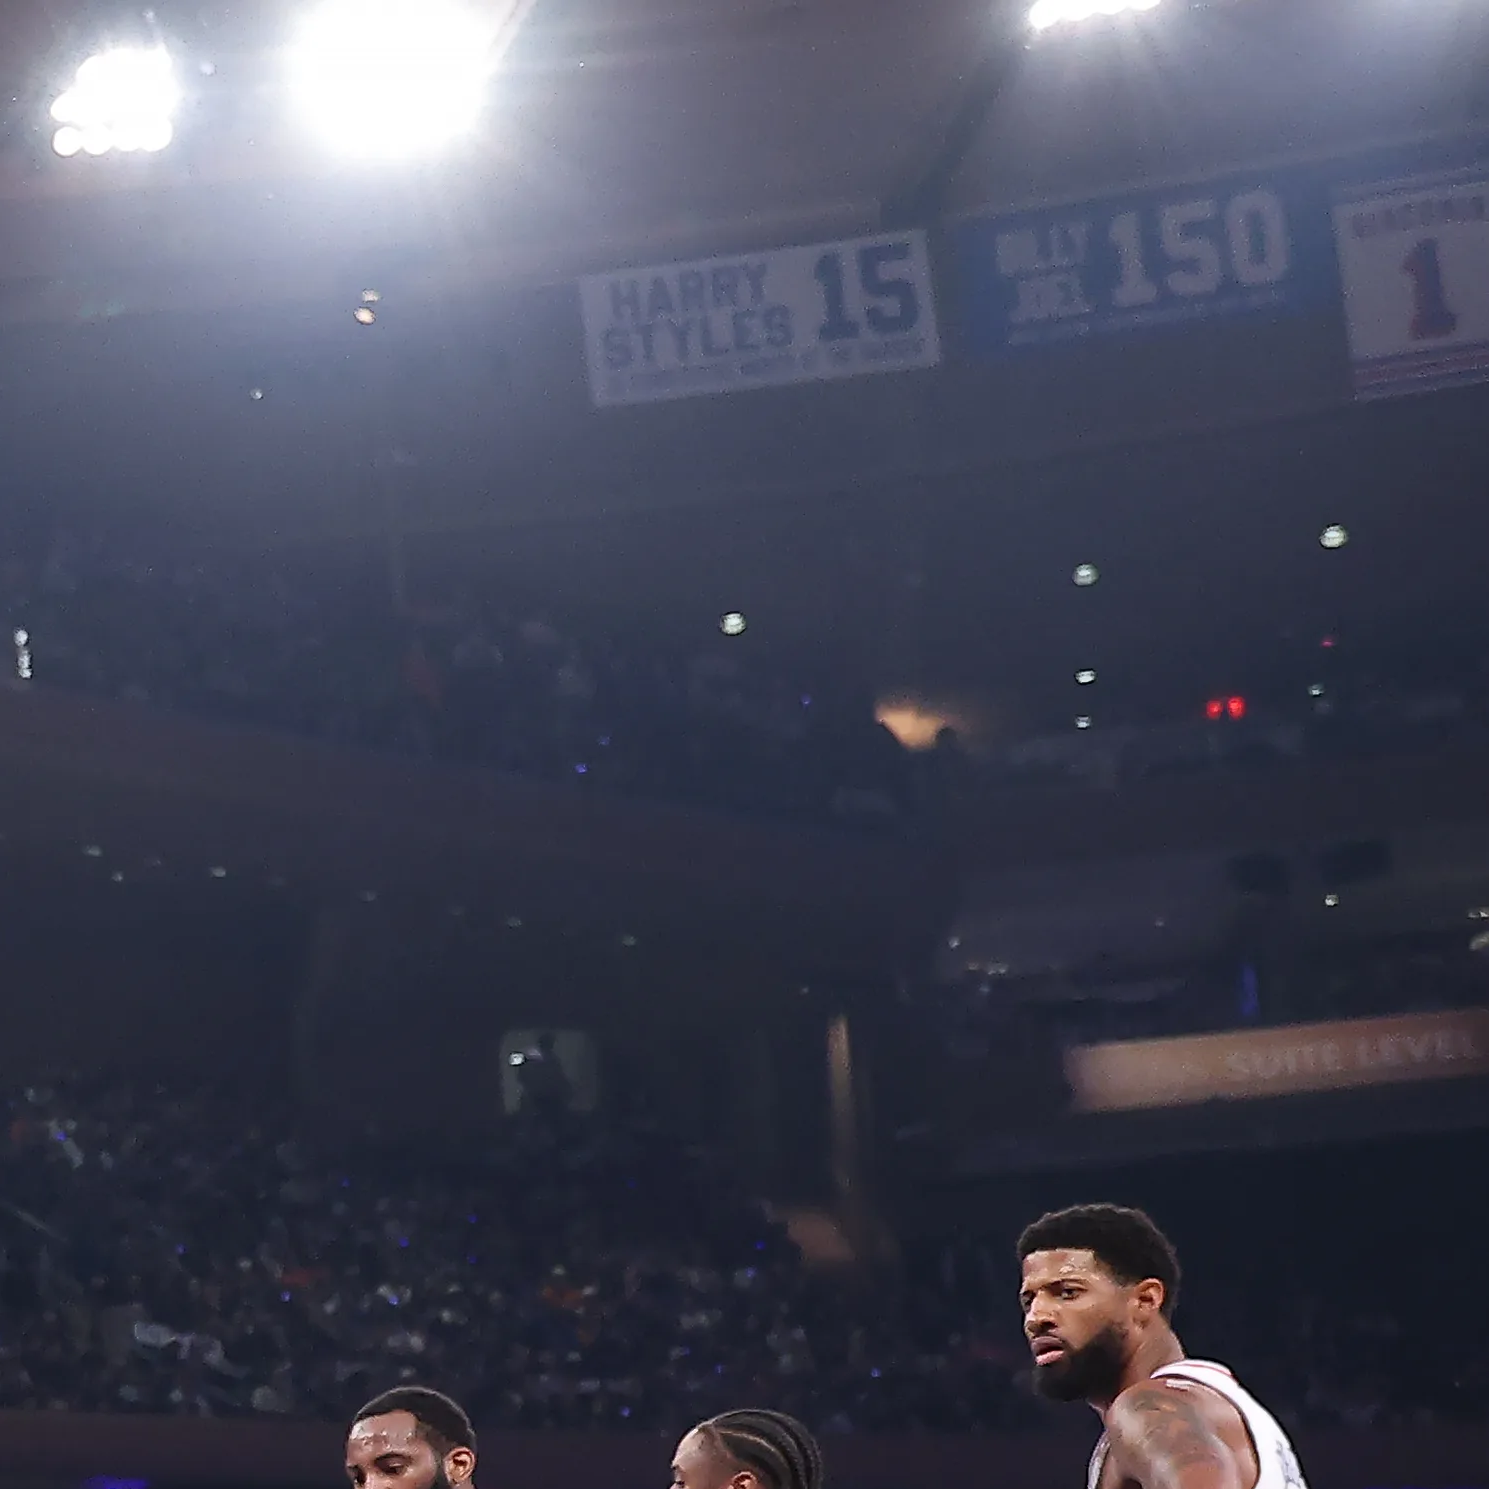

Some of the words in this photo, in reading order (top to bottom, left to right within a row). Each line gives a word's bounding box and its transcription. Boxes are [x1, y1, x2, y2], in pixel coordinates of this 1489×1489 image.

[609, 262, 768, 322] HARRY
[815, 241, 921, 341] 15
[1108, 188, 1289, 308] 150
[602, 304, 794, 370] STYLES
